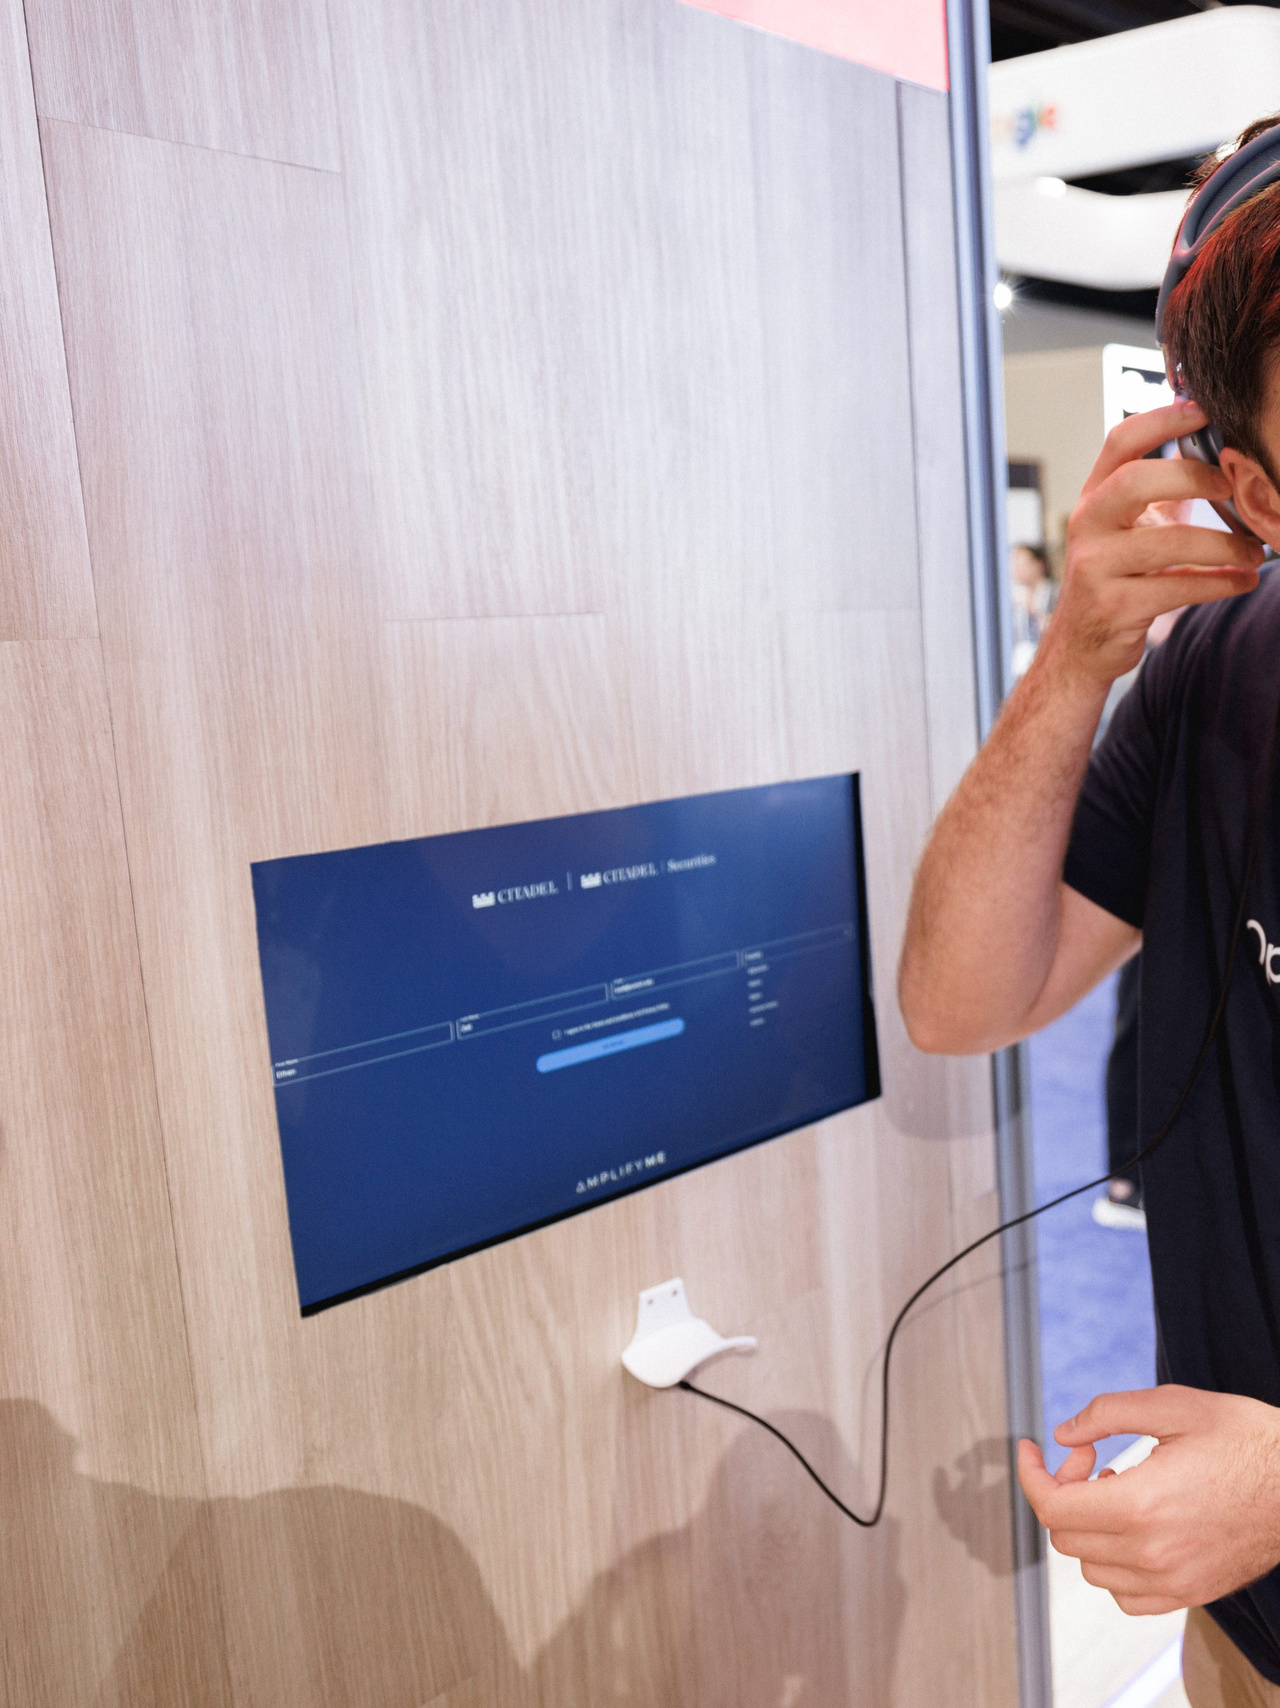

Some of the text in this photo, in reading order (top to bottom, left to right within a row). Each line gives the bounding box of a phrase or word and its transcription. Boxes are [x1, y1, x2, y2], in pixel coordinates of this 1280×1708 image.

[603, 853, 717, 885] CITADEL Securities
[497, 880, 559, 904] CITADEL
[576, 1150, 666, 1194] AMPLIFYME
